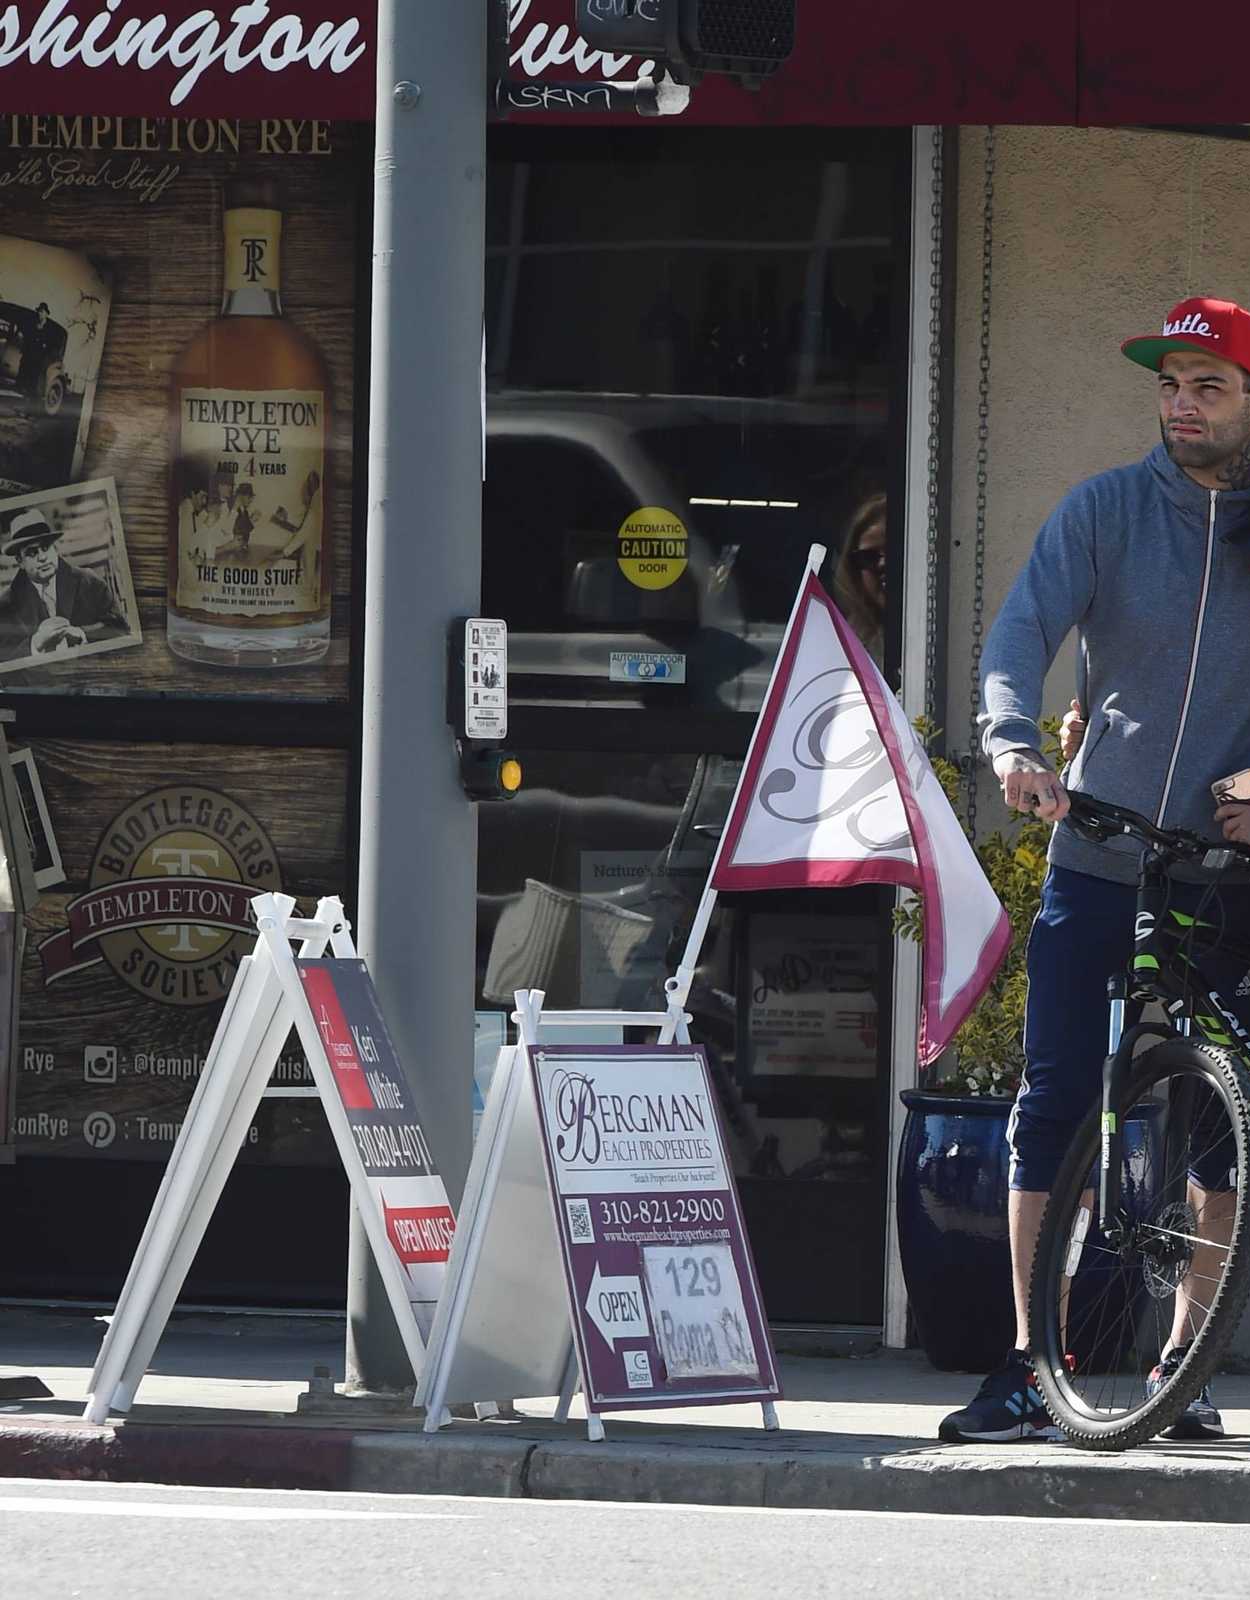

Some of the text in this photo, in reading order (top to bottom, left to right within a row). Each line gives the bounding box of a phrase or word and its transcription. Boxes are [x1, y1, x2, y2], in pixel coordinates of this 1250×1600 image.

[8, 115, 333, 154] TEMPLETON RYE
[186, 398, 318, 426] TEMPLETON
[223, 426, 281, 454] RYE
[244, 457, 256, 477] 4
[260, 461, 286, 476] YEARS
[624, 523, 682, 534] AUTOMATIC
[621, 540, 686, 557] CAUTION
[197, 565, 304, 586] THE GOOD STUFF
[638, 563, 668, 573] DOOR
[612, 653, 684, 665] AUTOMATIC DOOR
[100, 795, 274, 880] BOOTLEGGERS
[82, 888, 234, 928] TEMPLETON
[121, 948, 240, 999] SOCIETY
[24, 1047, 54, 1073] Rye
[640, 1138, 713, 1161] PROPERTIES
[600, 1198, 724, 1224] 310-821-2900
[393, 1219, 428, 1253] OPEN
[664, 1256, 722, 1297] 129
[600, 1291, 642, 1323] OPEN
